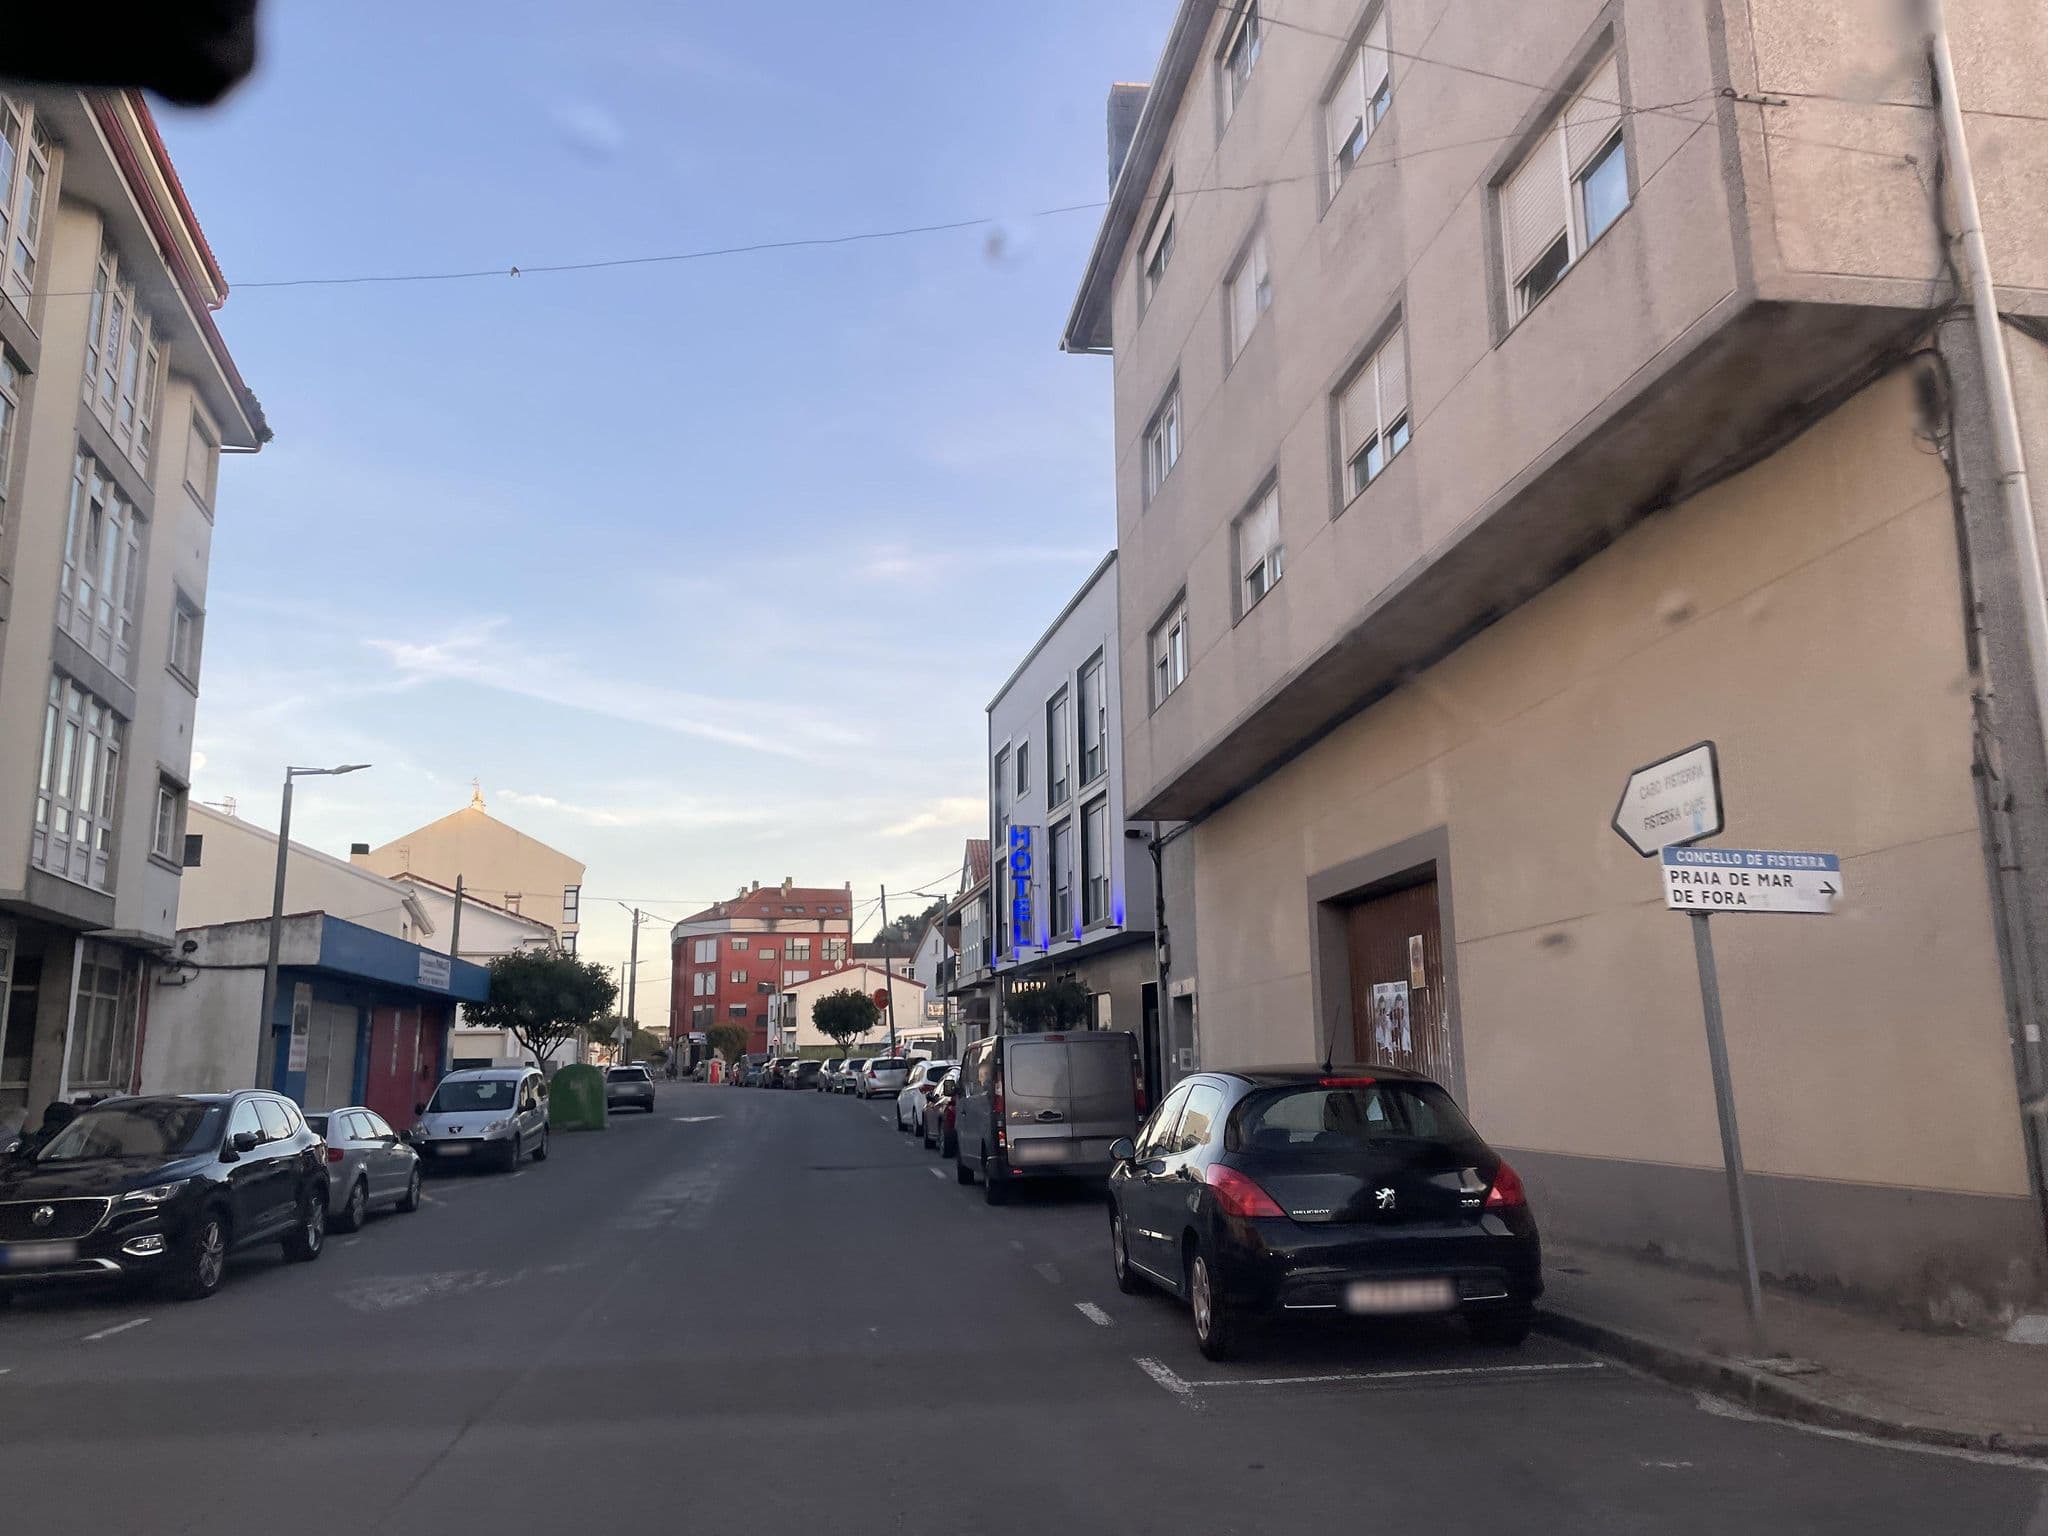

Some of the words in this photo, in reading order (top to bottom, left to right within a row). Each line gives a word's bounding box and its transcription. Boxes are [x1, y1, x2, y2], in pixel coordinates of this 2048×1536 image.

[1676, 851, 1742, 864] CONCELLO
[1746, 854, 1763, 866] DE
[1767, 854, 1826, 868] FISTERRA
[1010, 824, 1031, 945] HOTEL
[1670, 870, 1721, 885] PRAIA
[1729, 872, 1750, 886] DE
[1758, 874, 1793, 887] MAR
[1673, 889, 1694, 903] DE
[1702, 891, 1747, 904] FORA
